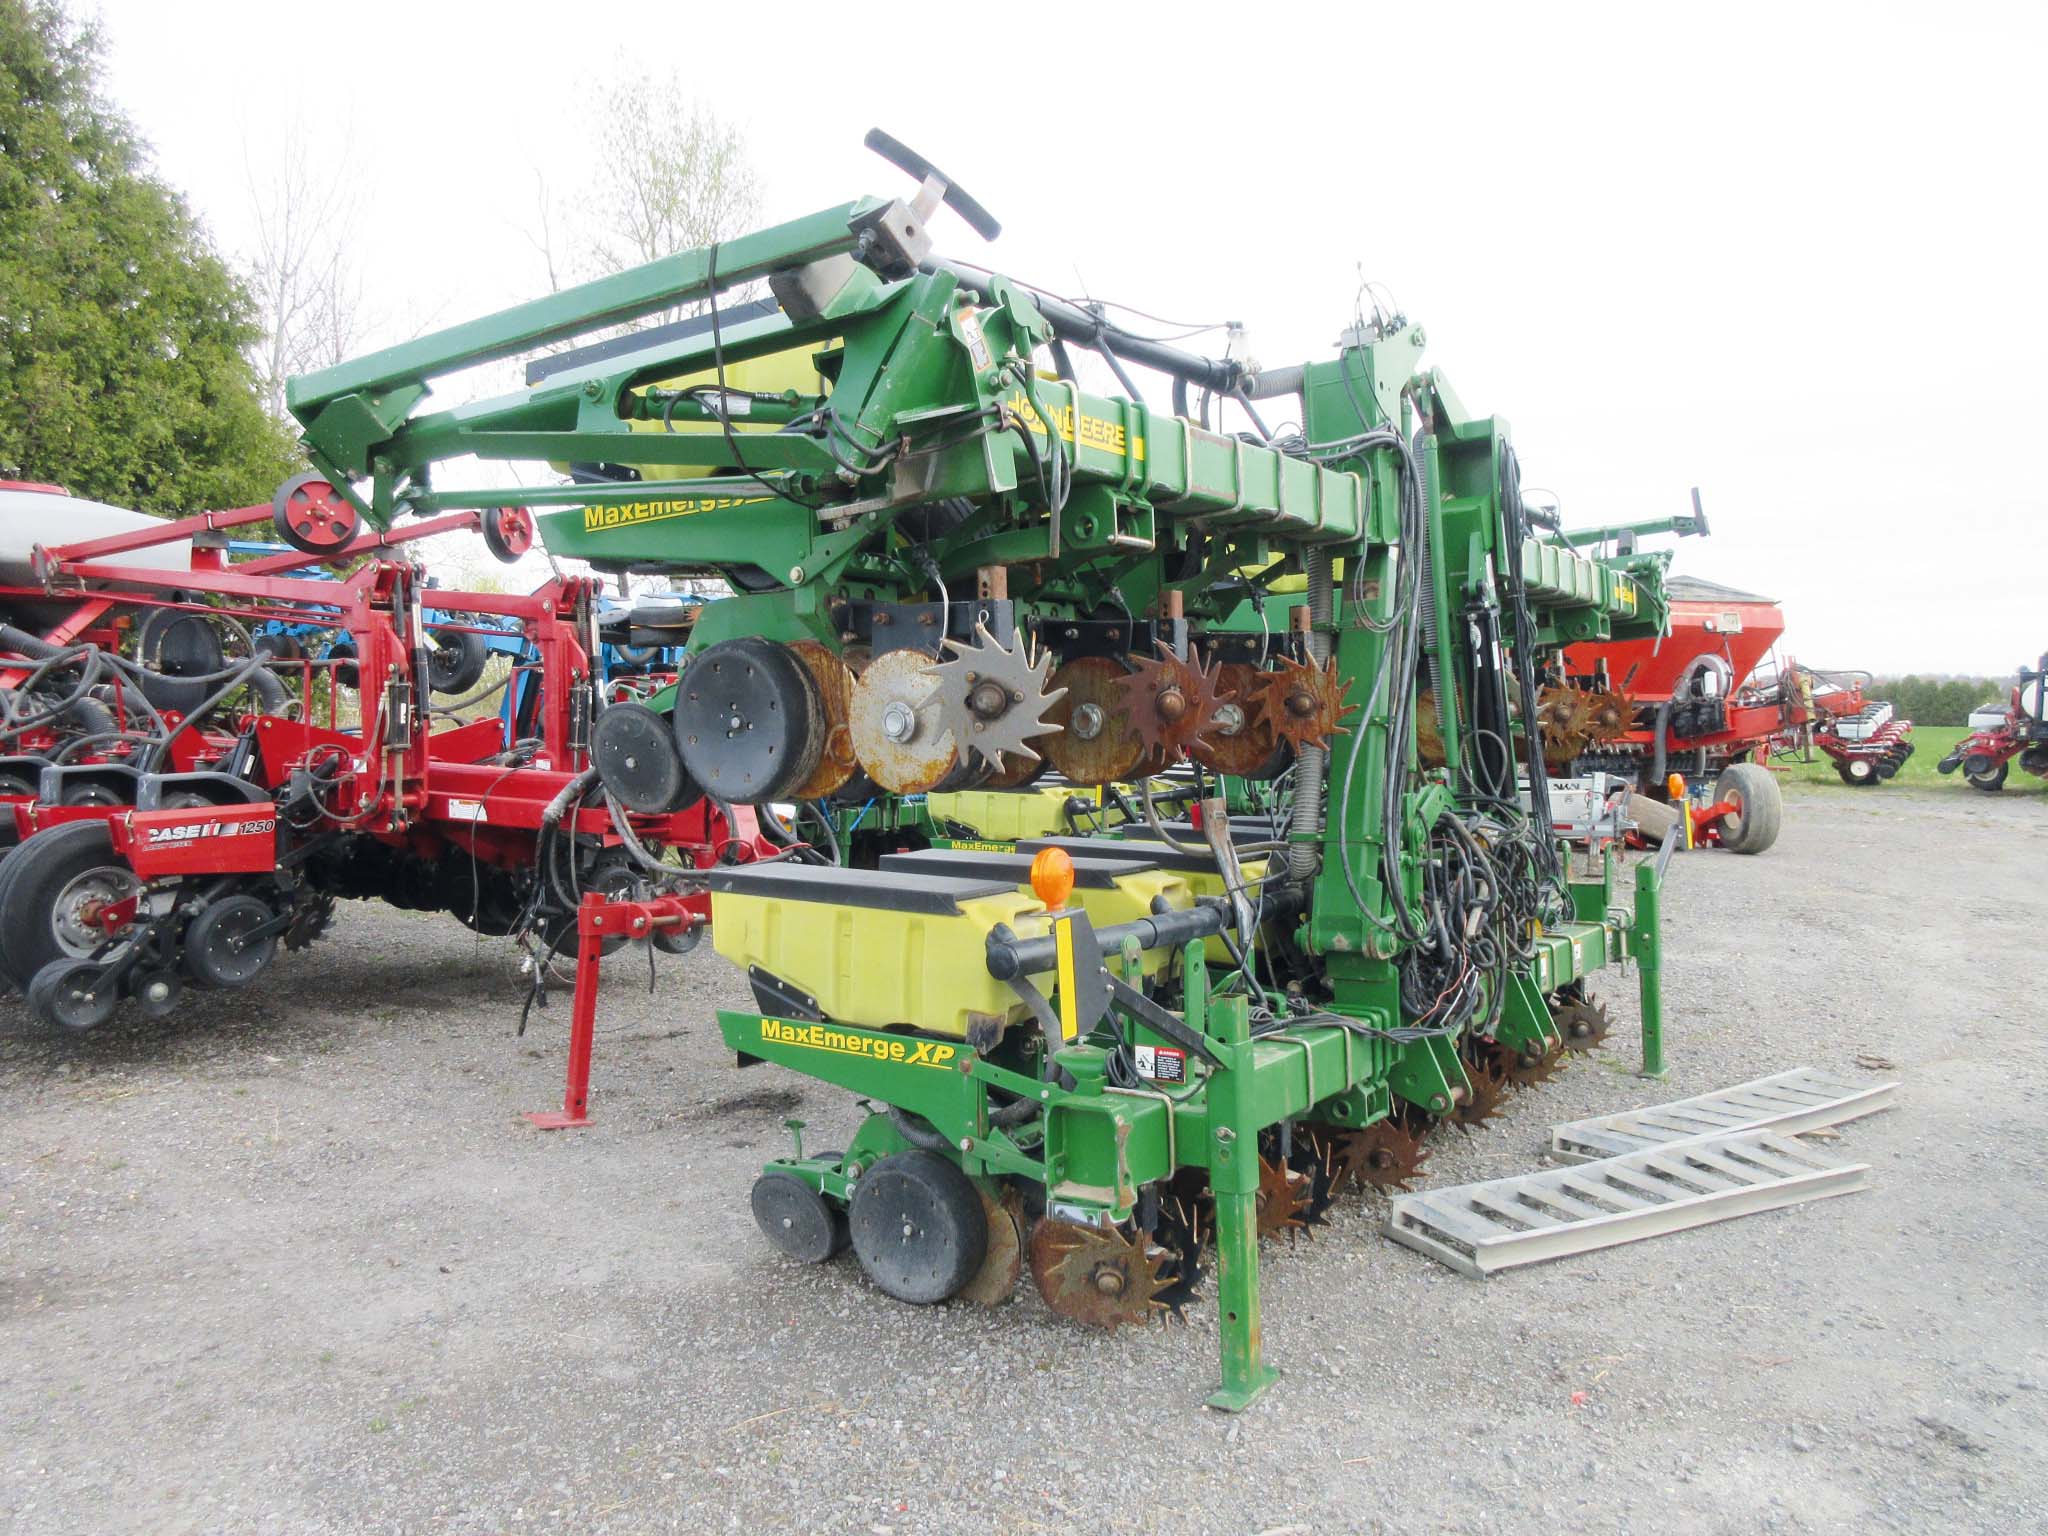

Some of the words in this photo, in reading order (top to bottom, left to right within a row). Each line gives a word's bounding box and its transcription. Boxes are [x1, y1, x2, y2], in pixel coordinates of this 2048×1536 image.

[147, 824, 201, 842] CASE
[239, 820, 276, 834] 1250
[761, 1019, 905, 1060] MaxEmerge
[904, 1041, 956, 1065] XP
